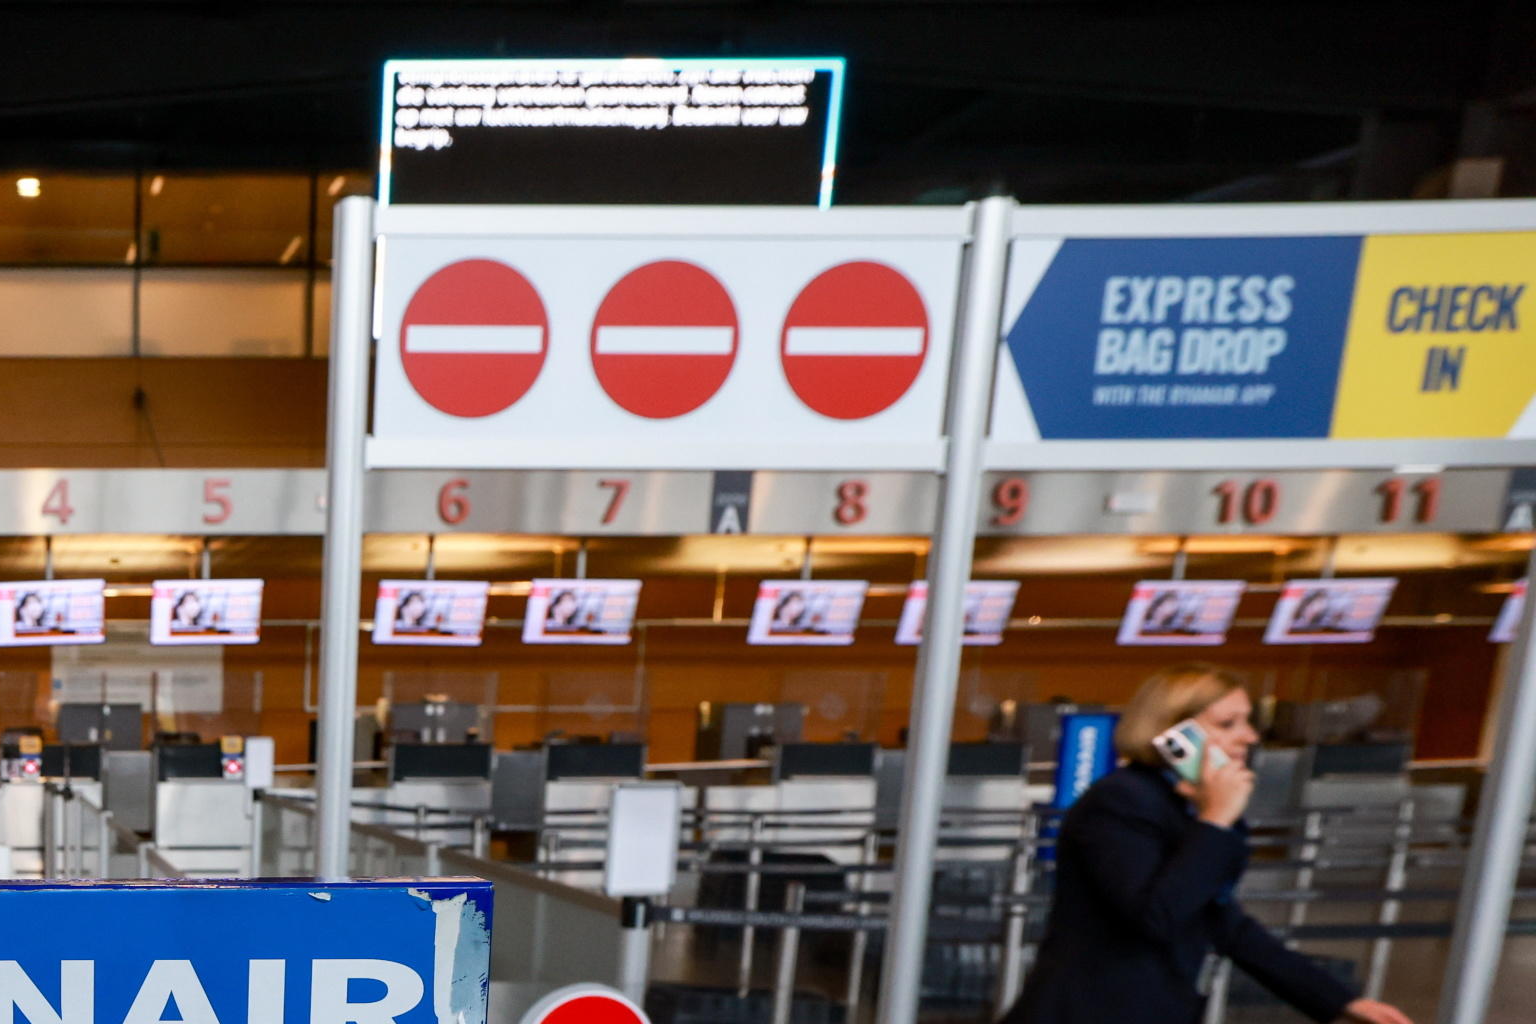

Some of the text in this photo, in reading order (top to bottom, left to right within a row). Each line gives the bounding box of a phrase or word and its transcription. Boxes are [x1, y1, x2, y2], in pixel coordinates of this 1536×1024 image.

[1100, 274, 1295, 325] EXPRESS
[1385, 282, 1526, 335] CHECK
[1093, 328, 1287, 375] BAG DROP
[1418, 345, 1467, 394] IN
[41, 478, 75, 525] 4
[202, 478, 234, 525] 5
[438, 479, 472, 526] 6
[598, 479, 631, 526] 7
[715, 504, 743, 534] A
[833, 479, 869, 527] 8
[990, 477, 1030, 526] 9
[1213, 477, 1280, 525] 10
[1376, 477, 1441, 525] 11
